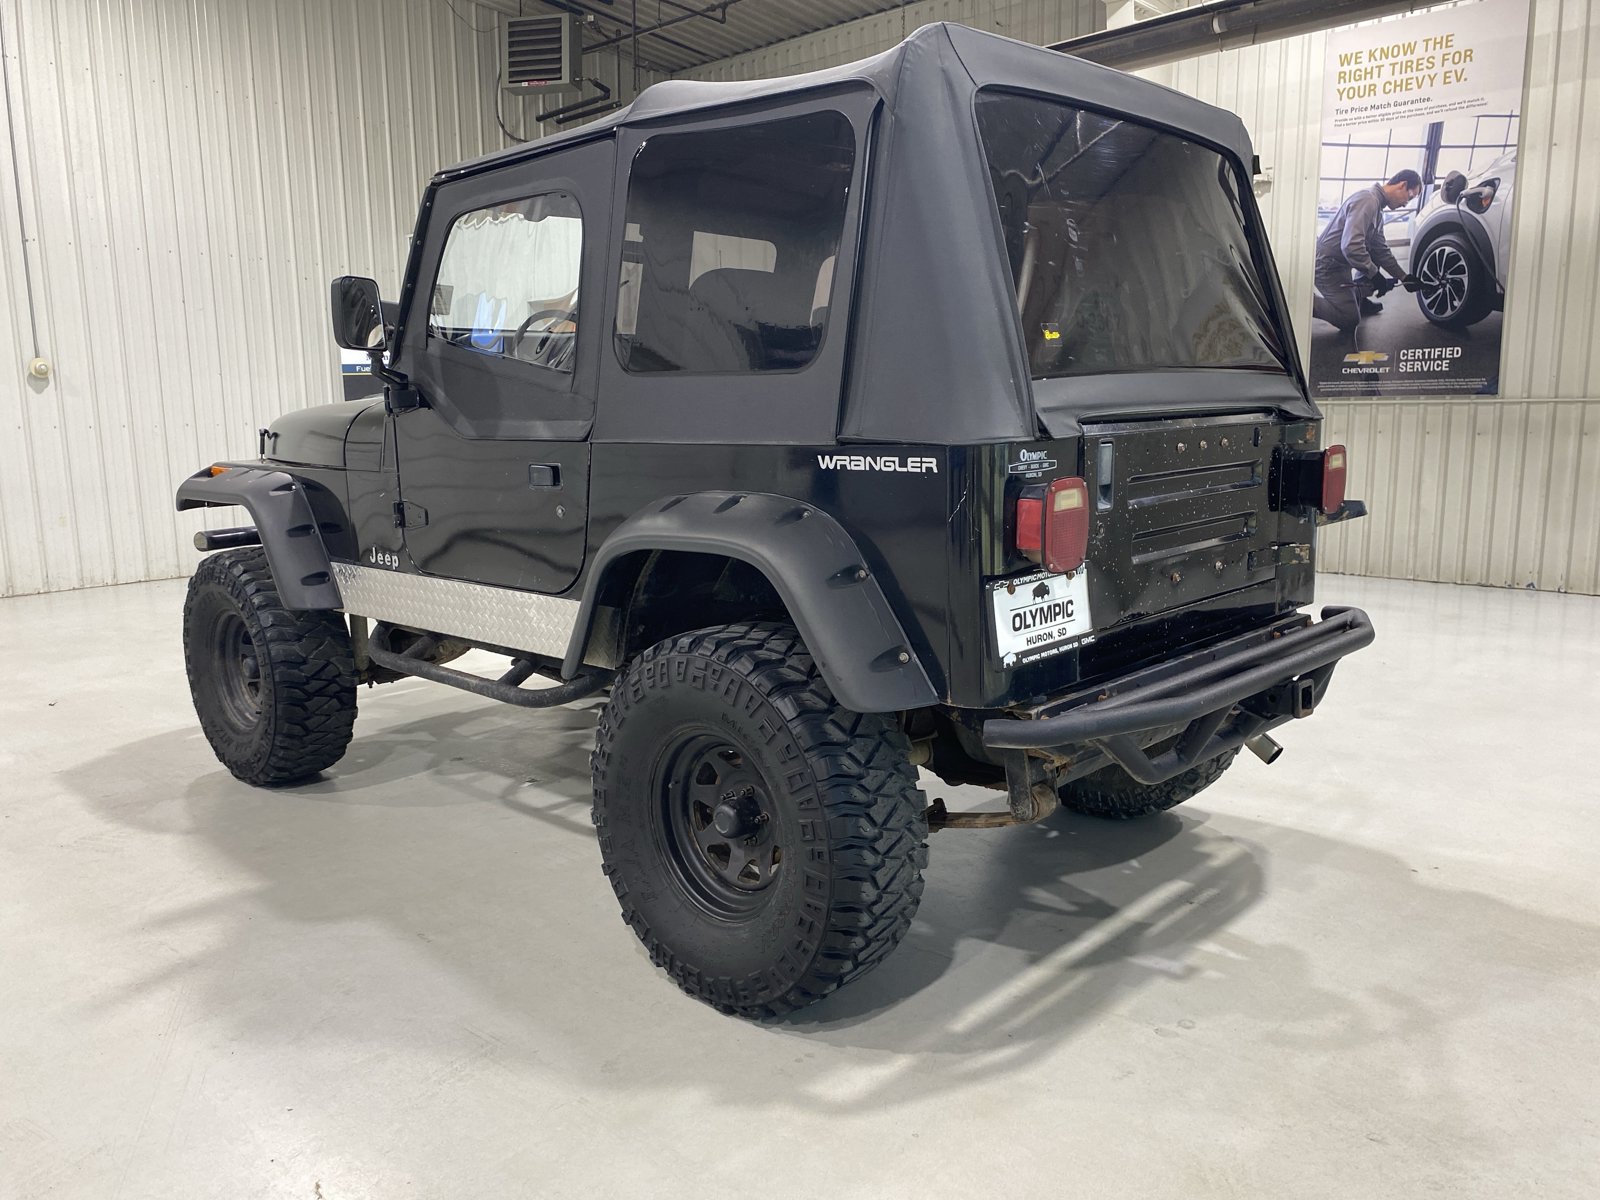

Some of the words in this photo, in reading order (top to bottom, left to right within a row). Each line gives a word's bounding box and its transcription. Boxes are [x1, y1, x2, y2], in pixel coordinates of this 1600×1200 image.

[1339, 51, 1363, 67] WE
[1368, 41, 1417, 62] KNOW
[1423, 34, 1454, 52] THE
[1337, 64, 1384, 84] RIGHT
[1389, 56, 1435, 76] TIRES
[1441, 48, 1473, 67] FOR
[1337, 84, 1377, 101] YOUR
[1382, 73, 1438, 94] CHEVY
[1442, 68, 1467, 85] EV.
[1369, 102, 1391, 111] Match
[1393, 97, 1432, 107] Guarantee.
[1400, 347, 1461, 360] CERTIFIED
[1399, 360, 1450, 373] SERVICE
[817, 455, 938, 473] WRANGLER
[370, 547, 399, 570] Jeep
[1012, 599, 1074, 632] OLYMPIC
[1026, 630, 1055, 646] HURON,
[1057, 627, 1067, 637] SD
[1081, 635, 1095, 645] GMC
[1022, 653, 1041, 664] OLYMPIC
[1059, 643, 1072, 652] HURON
